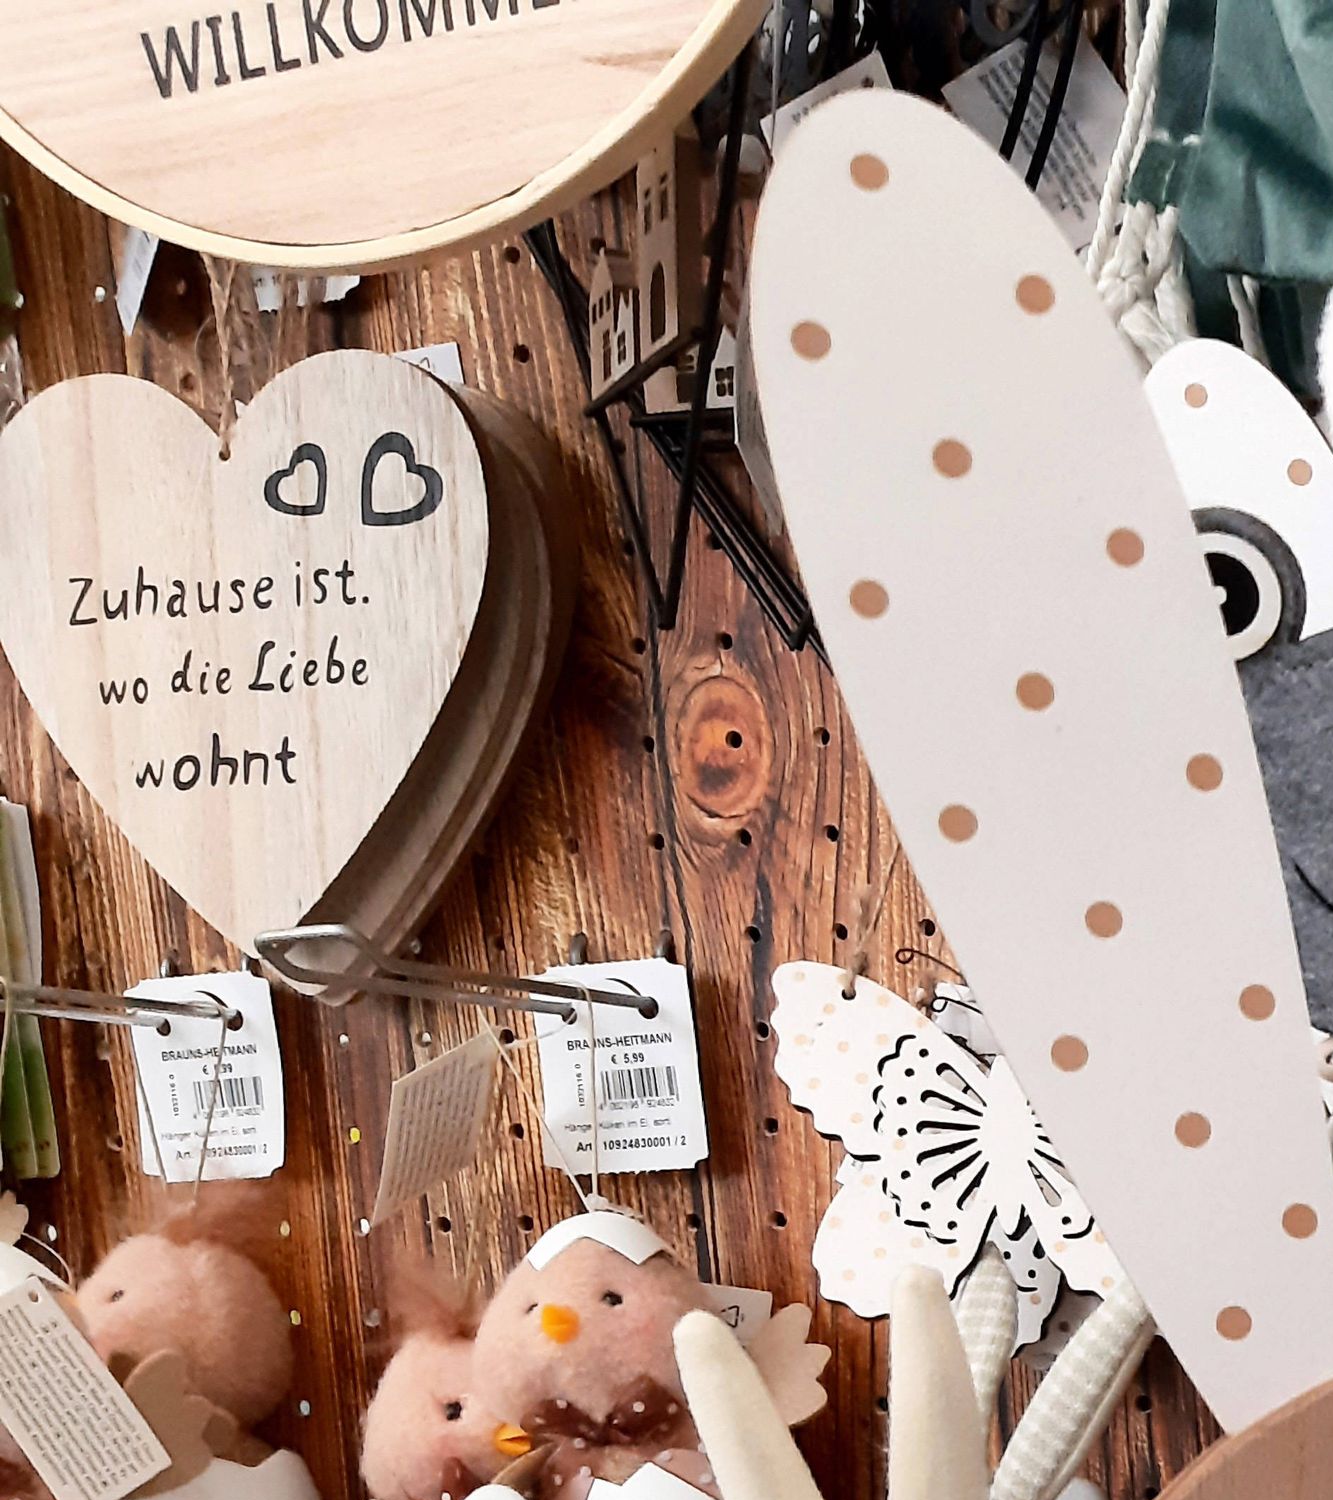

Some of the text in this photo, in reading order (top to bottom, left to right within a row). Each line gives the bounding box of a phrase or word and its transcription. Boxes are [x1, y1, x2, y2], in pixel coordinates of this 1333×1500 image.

[139, 0, 561, 99] WILLKOM
[68, 566, 274, 627] Zuhause
[100, 636, 369, 706] wo die Liebe
[135, 734, 297, 789] wohnt
[162, 1043, 257, 1062] BRAUNS-HETMANN
